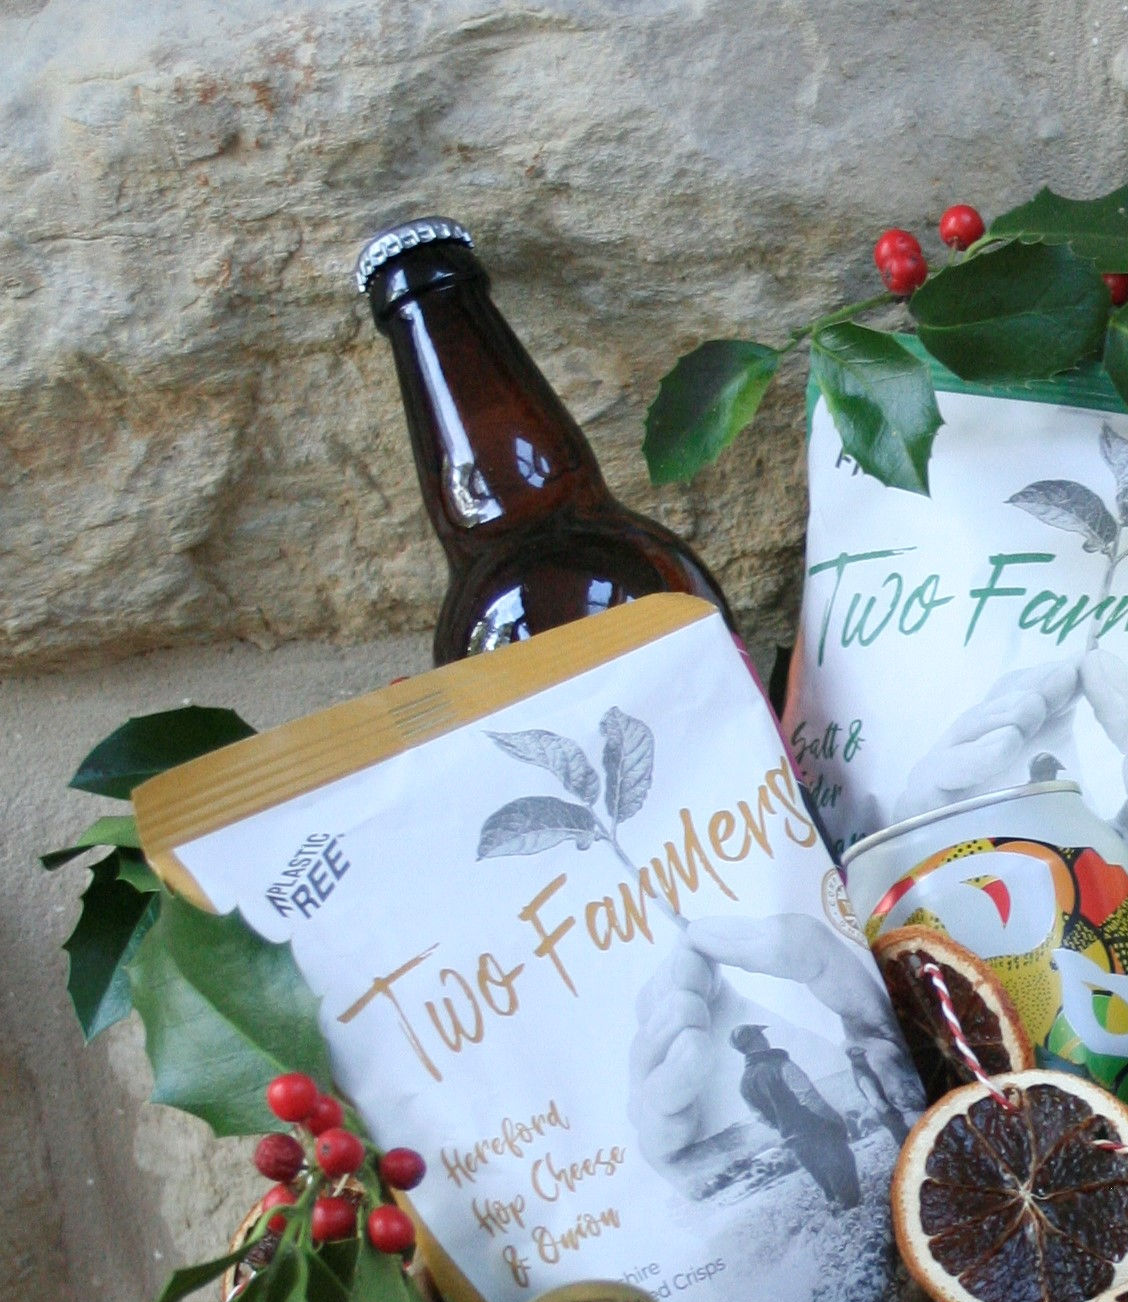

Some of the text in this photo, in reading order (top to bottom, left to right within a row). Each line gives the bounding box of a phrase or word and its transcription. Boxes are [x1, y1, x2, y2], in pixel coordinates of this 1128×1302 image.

[808, 546, 956, 667] Two
[791, 719, 867, 765] Salt &
[266, 833, 330, 895] PLASTIC
[336, 943, 526, 1083] Two
[518, 755, 818, 998] Farmers
[441, 1099, 571, 1189] Hereford
[472, 1146, 627, 1238] Hop Cheese
[502, 1207, 621, 1288] & Onion
[620, 1262, 661, 1284] hire
[672, 1258, 727, 1291] Crisps
